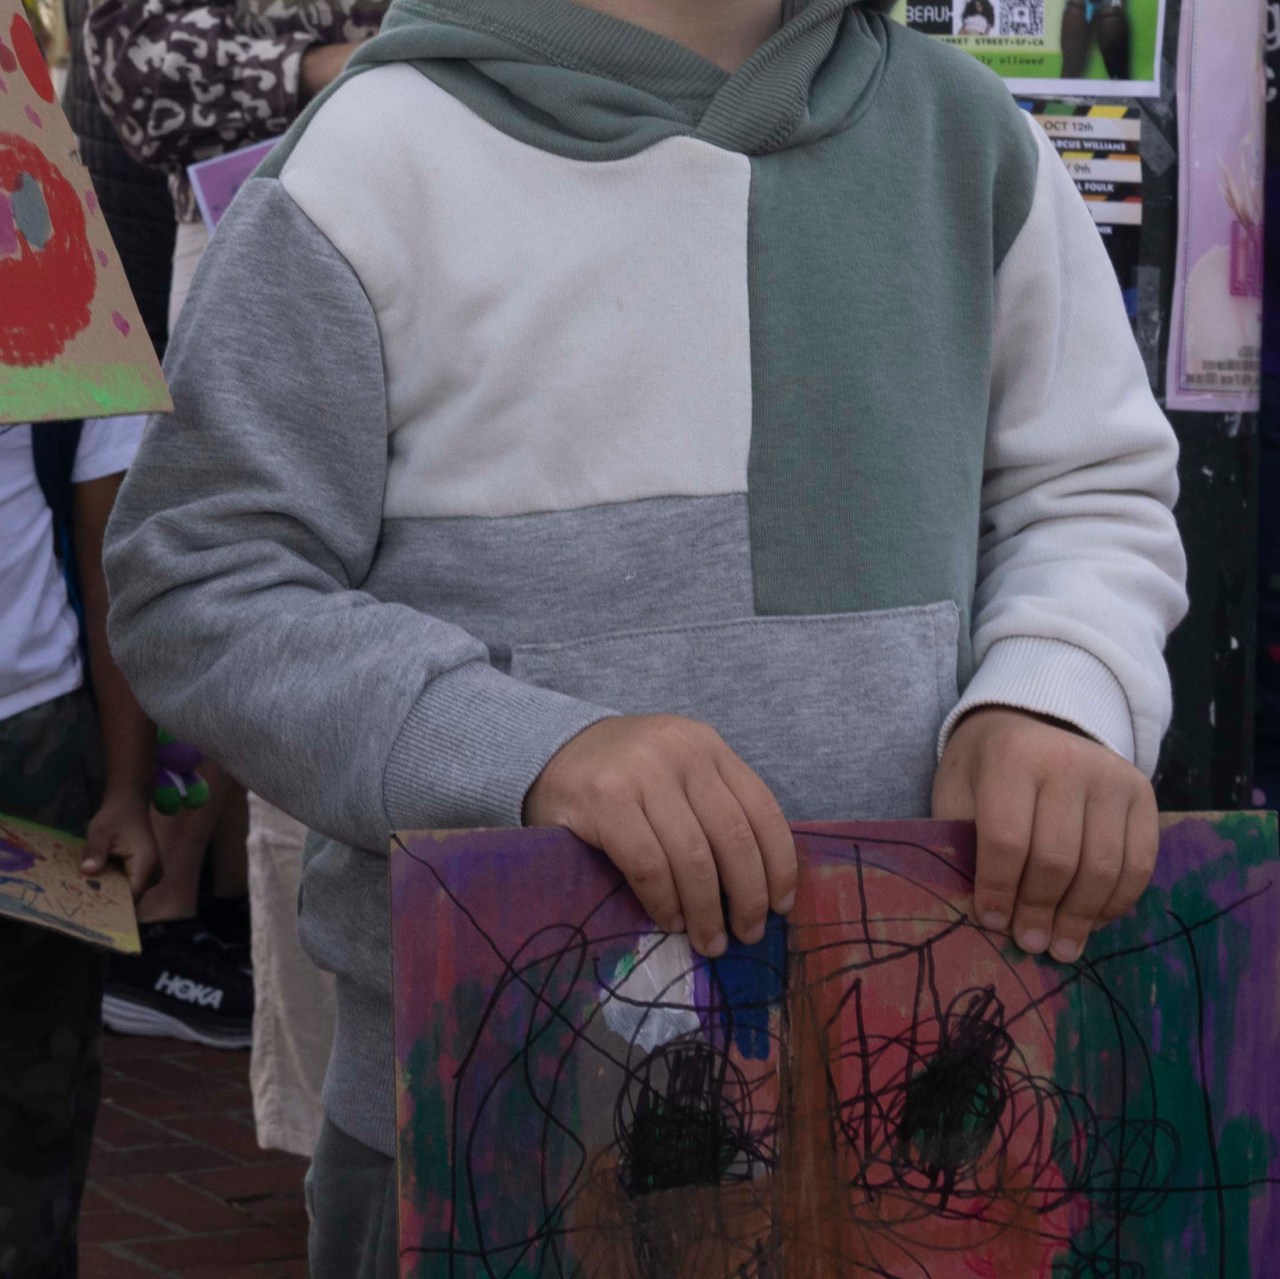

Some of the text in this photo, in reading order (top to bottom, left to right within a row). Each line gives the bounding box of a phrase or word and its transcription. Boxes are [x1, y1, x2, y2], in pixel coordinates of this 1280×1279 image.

[1044, 122, 1093, 132] OCT 12th
[153, 971, 224, 1010] HOKA
